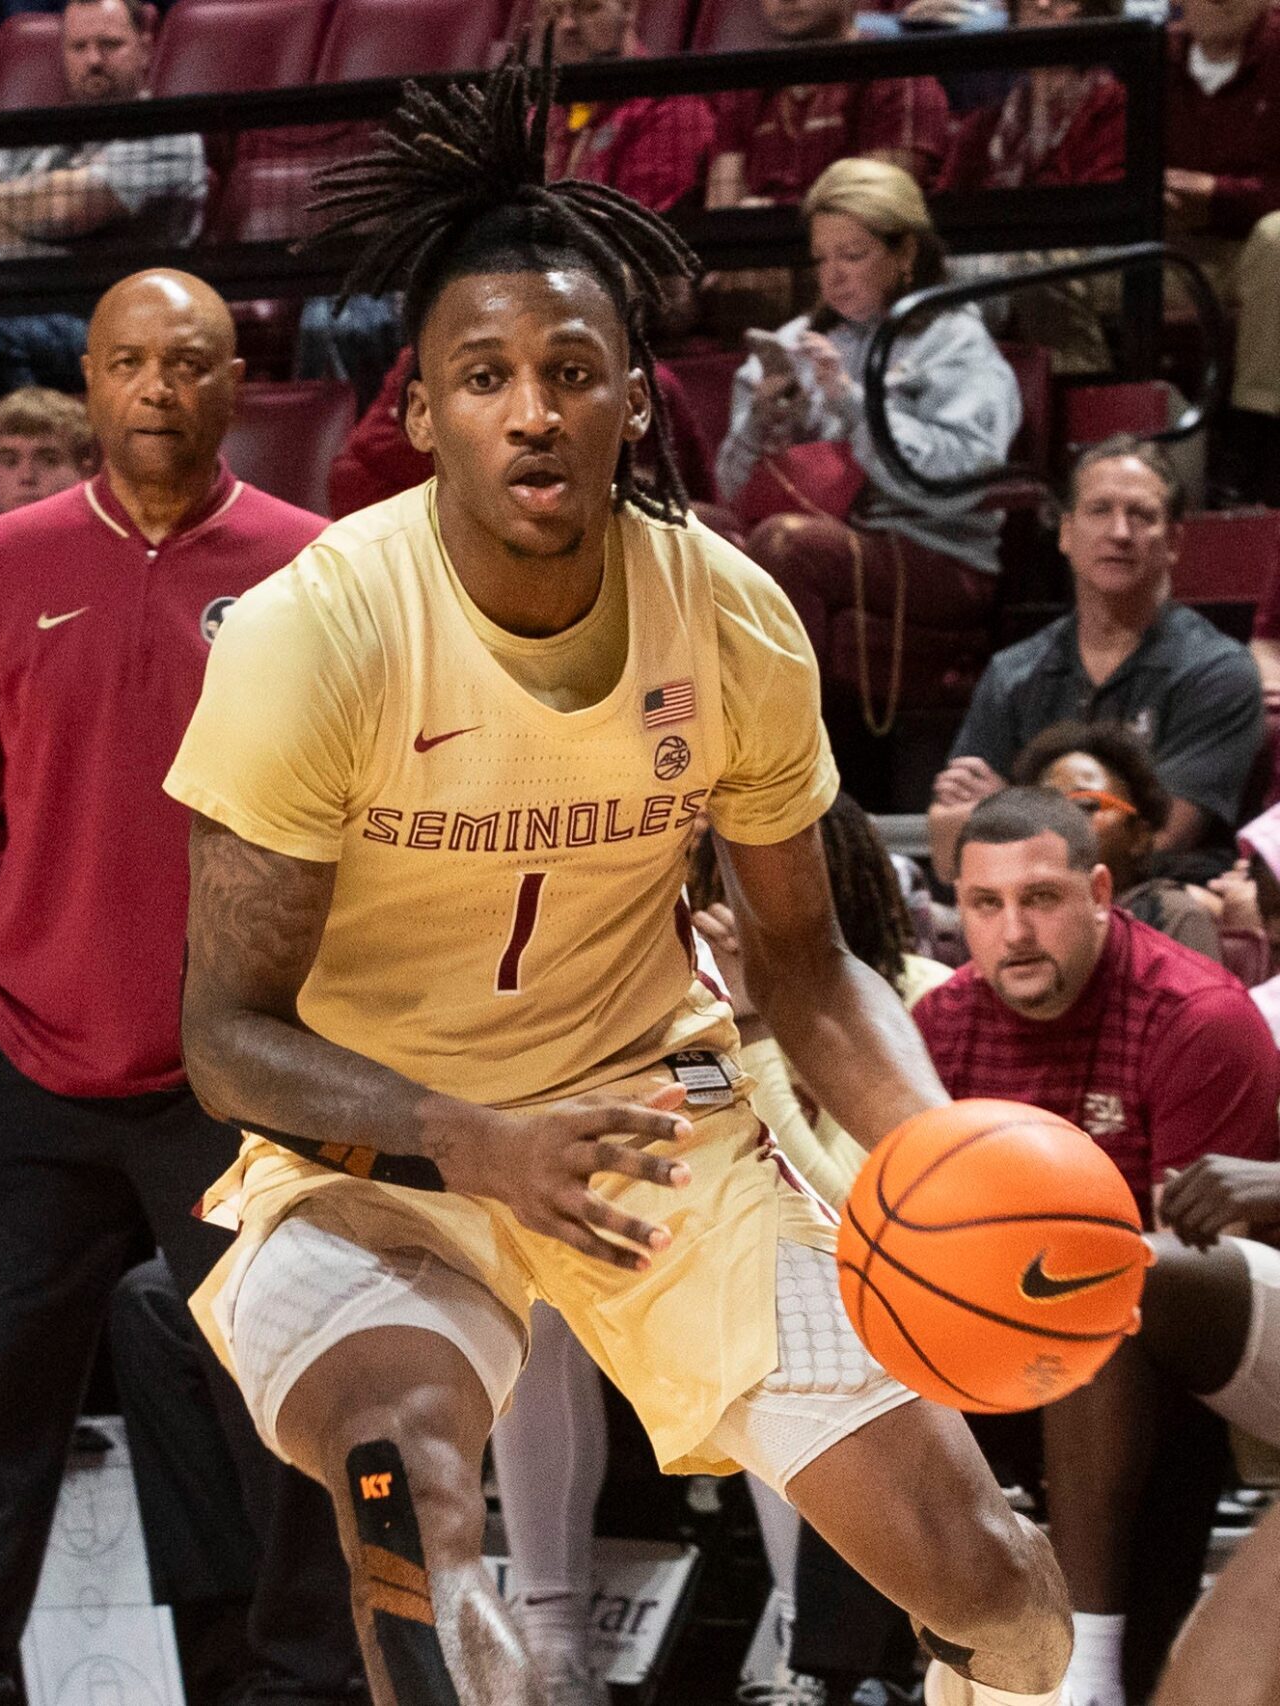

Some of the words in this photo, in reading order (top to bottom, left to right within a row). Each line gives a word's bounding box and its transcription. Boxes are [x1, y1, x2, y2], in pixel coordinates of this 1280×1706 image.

[363, 788, 710, 852] SEMINOLES
[494, 871, 549, 996] 1
[360, 1471, 393, 1500] KT
